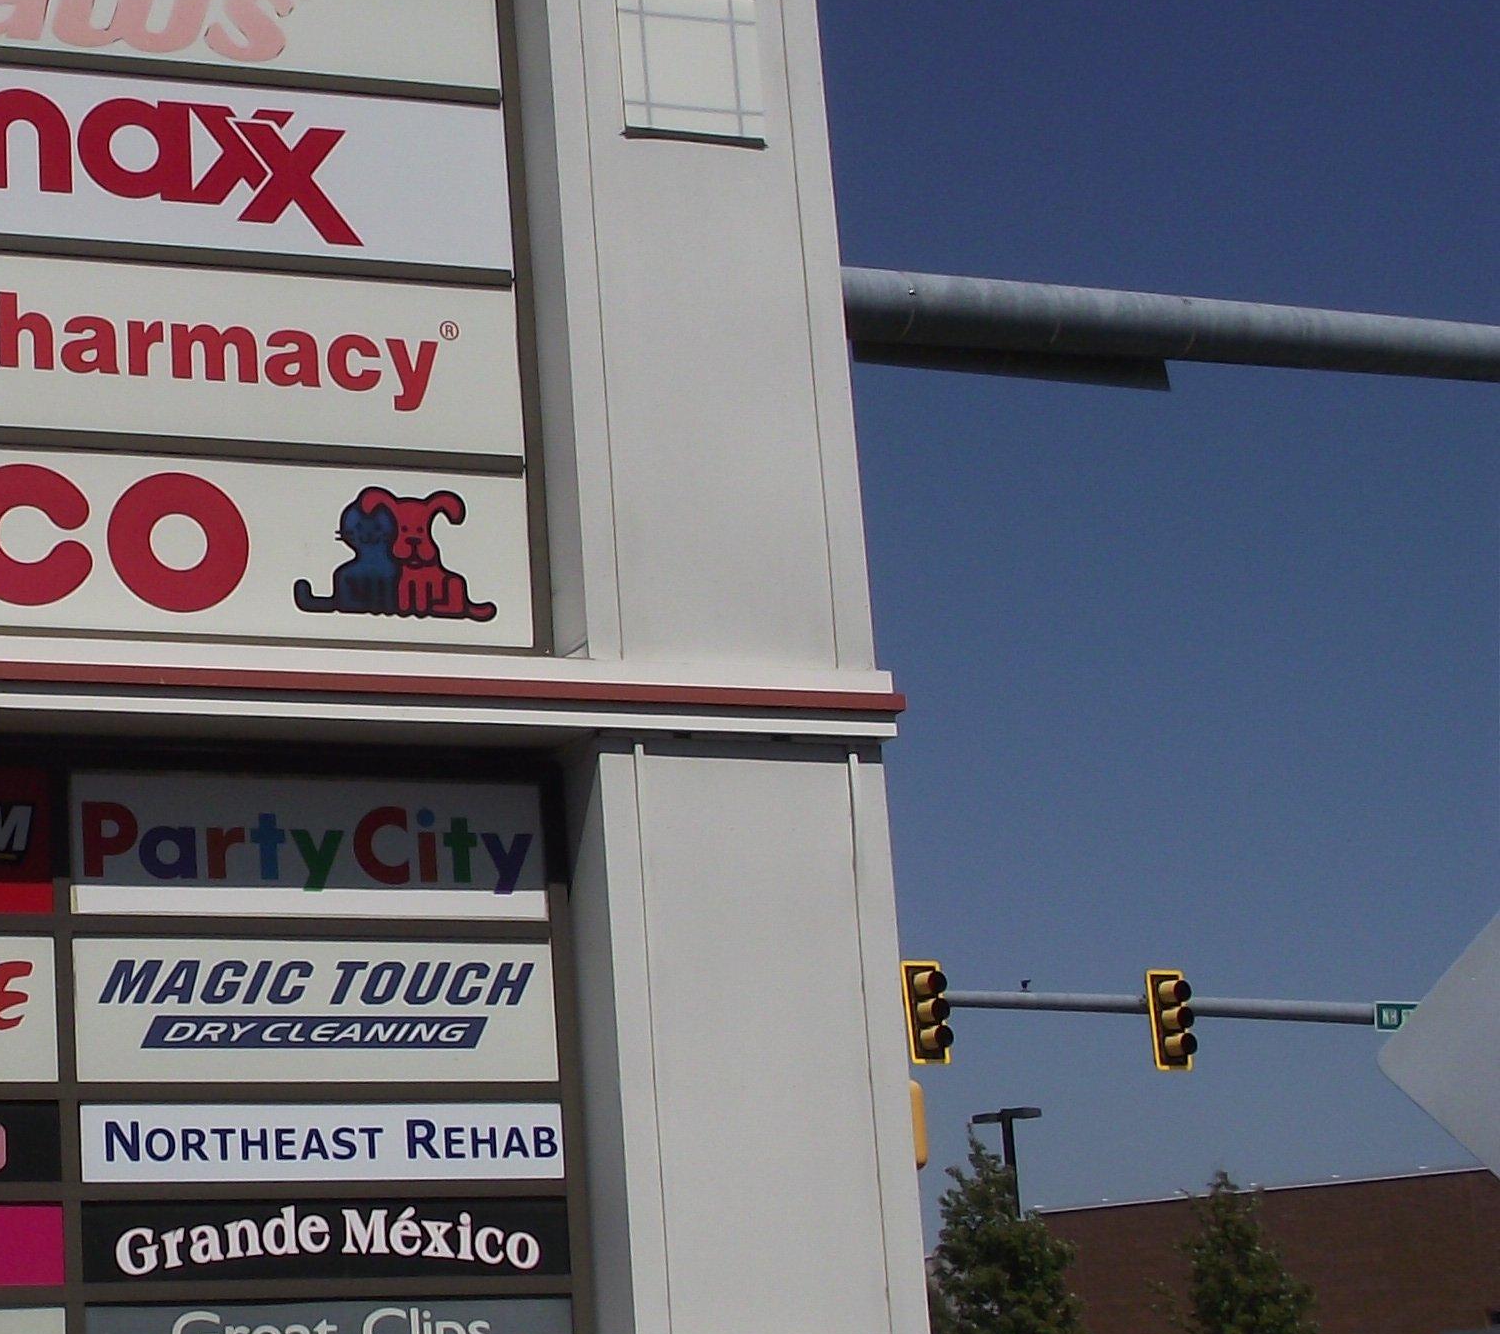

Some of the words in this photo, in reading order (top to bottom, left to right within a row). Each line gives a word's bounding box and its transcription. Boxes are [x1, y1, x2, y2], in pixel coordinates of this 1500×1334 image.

[98, 959, 315, 1006] MAGIC
[329, 960, 536, 1007] TOUCH
[163, 1022, 258, 1043] DRY
[261, 1022, 472, 1044] CLEANING
[104, 1120, 384, 1162] NORTHEAST
[406, 1119, 559, 1160] REHAB
[115, 1204, 332, 1276] Grande
[341, 1206, 541, 1270] México
